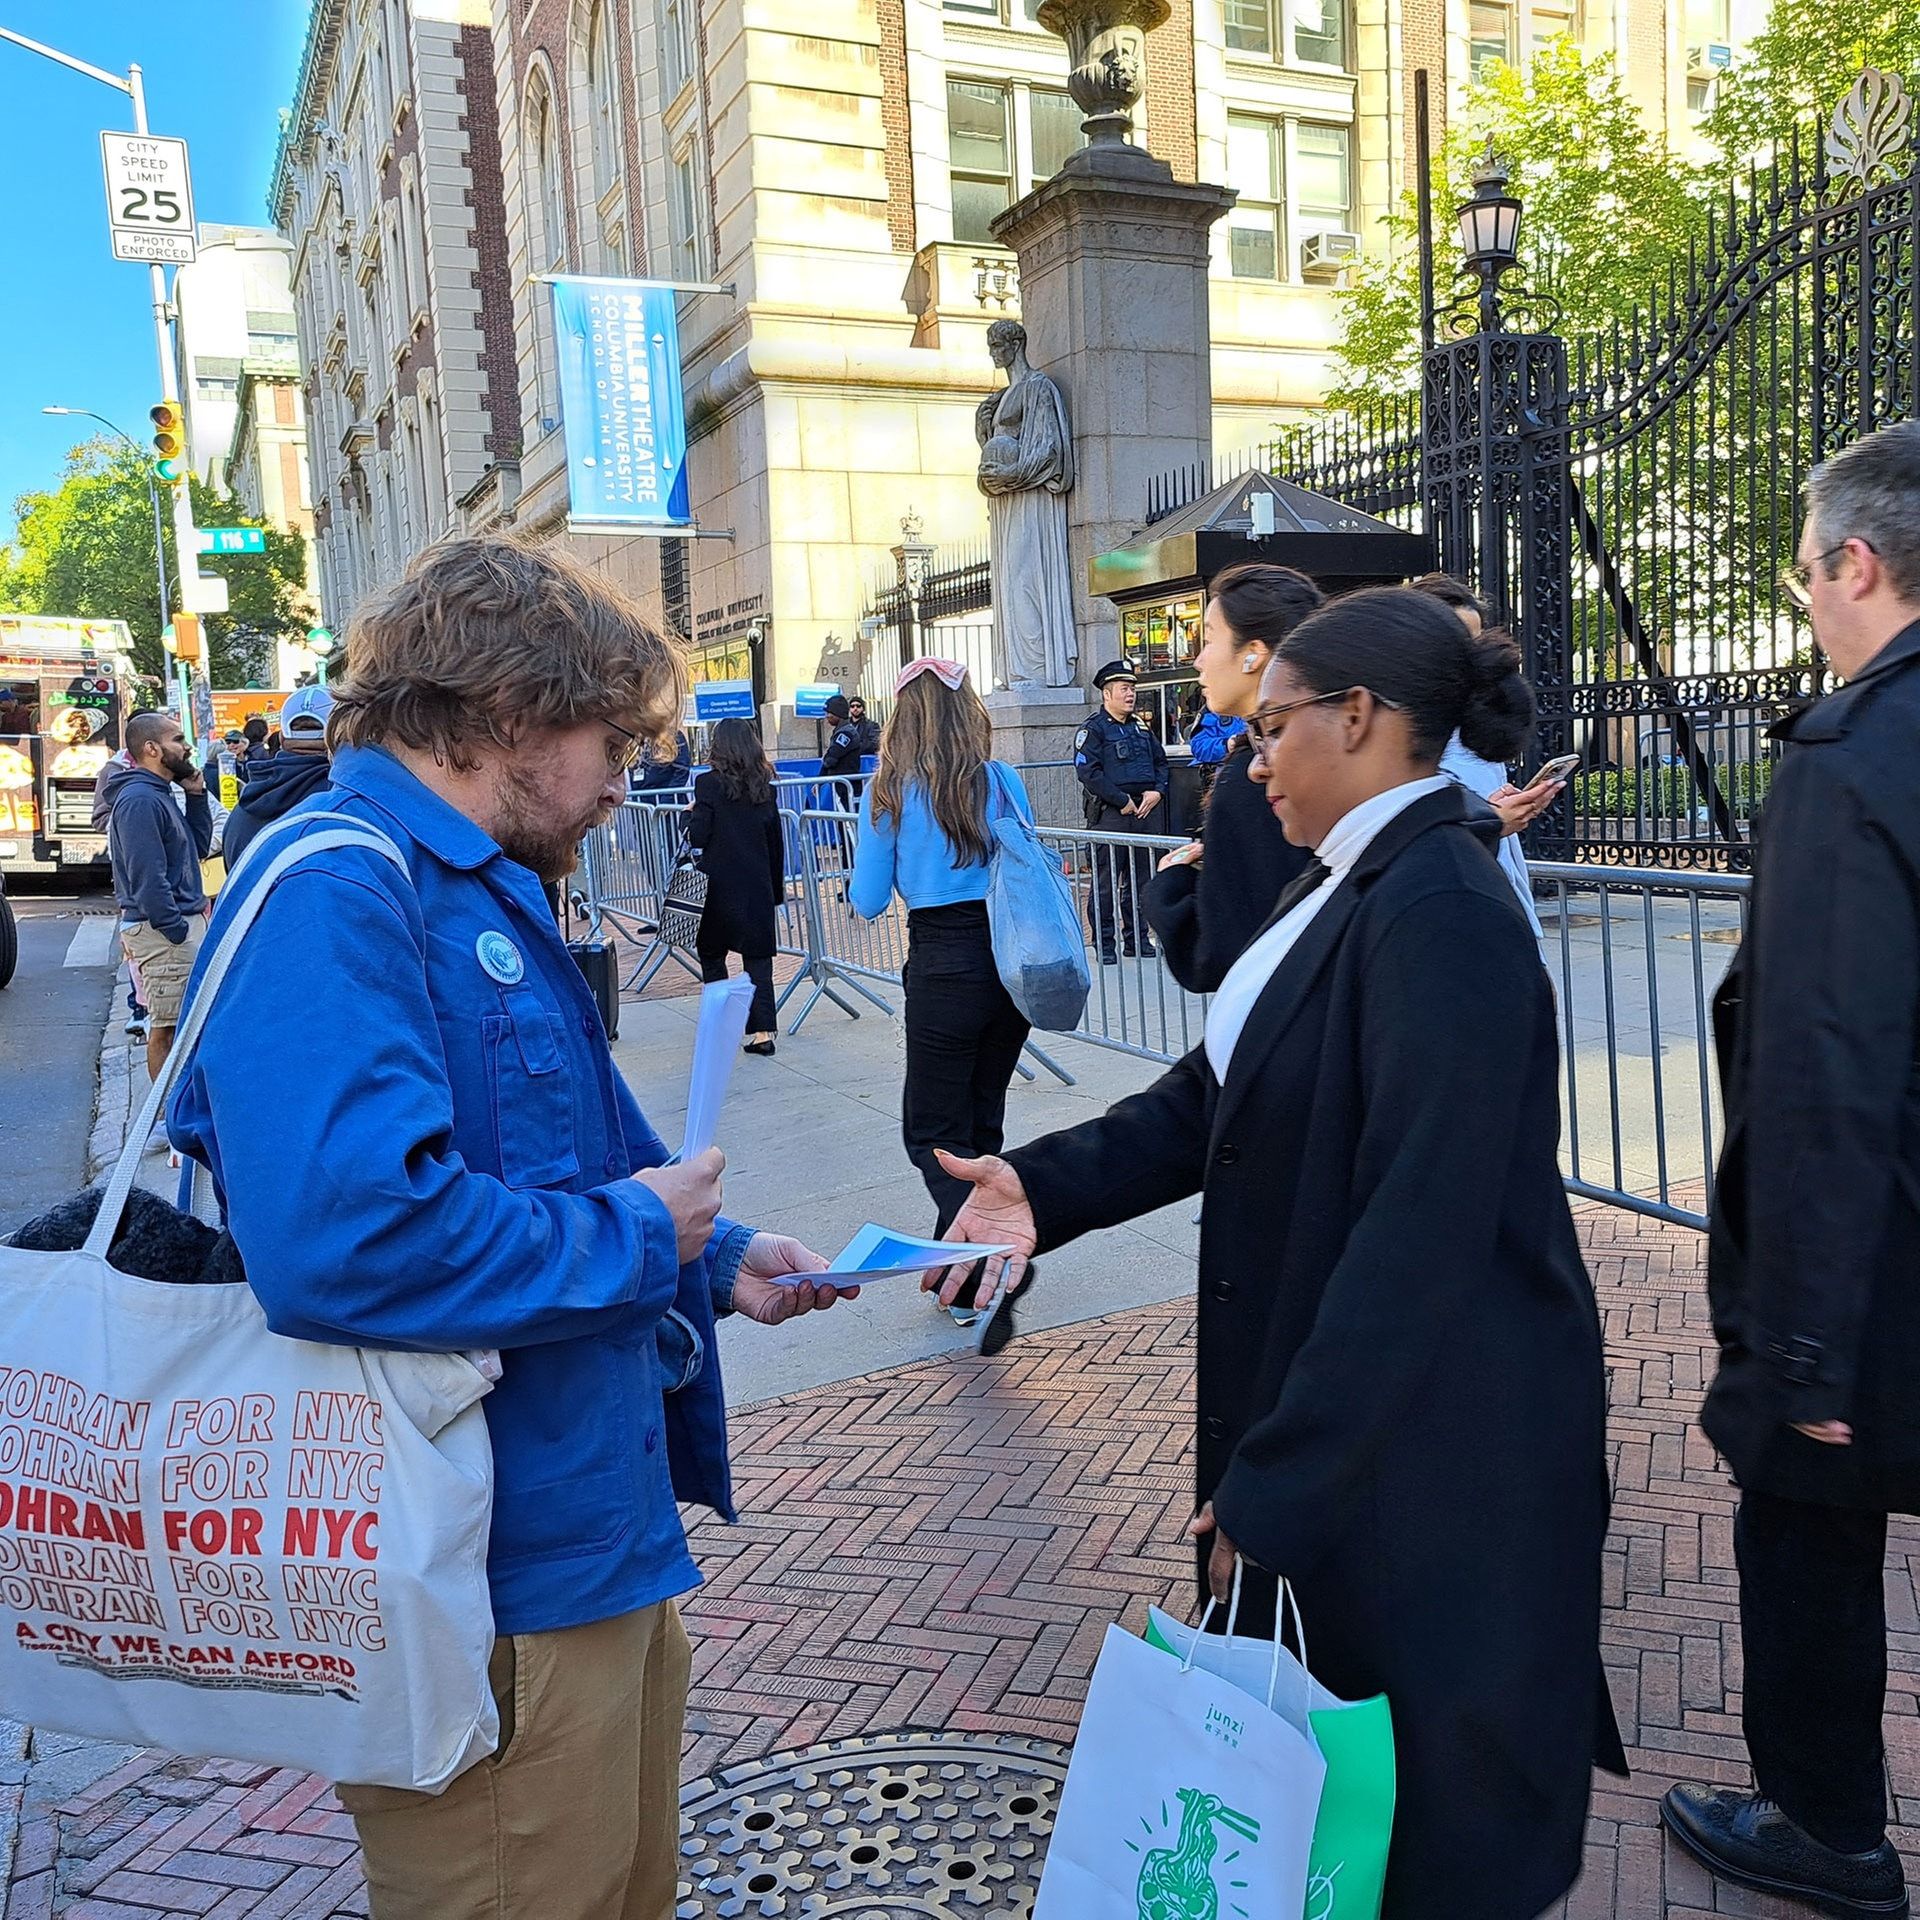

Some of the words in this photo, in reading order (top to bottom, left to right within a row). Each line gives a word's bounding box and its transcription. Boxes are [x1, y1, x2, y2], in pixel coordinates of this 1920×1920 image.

[121, 156, 168, 170] SPEED
[126, 142, 158, 154] CITY
[128, 171, 164, 183] LIMIT
[120, 187, 181, 223] 25
[121, 244, 188, 258] ENFORCED
[133, 235, 175, 247] PHOTO
[590, 294, 605, 368] SCHOOL
[604, 293, 626, 393] COLUMBIA
[621, 294, 651, 403] MILLER
[600, 412, 613, 446] THE
[612, 395, 635, 504] UNIVERSITY
[630, 403, 658, 504] THEATRE
[602, 457, 617, 501] ARTS
[220, 531, 244, 549] 116
[727, 593, 763, 617] UNIVERSITY
[799, 666, 849, 677] DODGE
[166, 1393, 275, 1449] FOR
[293, 1390, 385, 1447] NYC
[0, 1424, 140, 1504] OHRAN
[162, 1449, 269, 1503] FOR
[287, 1448, 384, 1504] NYC
[163, 1507, 264, 1555] FOR
[282, 1507, 379, 1560] NYC
[0, 1534, 155, 1593] OHRAN
[169, 1556, 271, 1601] FOR
[282, 1564, 379, 1611] NYC
[0, 1575, 167, 1632] OHRAN
[179, 1598, 280, 1640] FOR
[290, 1607, 387, 1652] NYC
[16, 1622, 39, 1640] A
[45, 1623, 103, 1653] CITY
[111, 1634, 163, 1654] WE
[168, 1645, 235, 1664] CAN
[245, 1649, 356, 1679] AFFORD
[18, 1639, 63, 1652] Freeze
[120, 1653, 149, 1665] Fast
[152, 1655, 164, 1666] &
[166, 1656, 191, 1674] Free
[193, 1665, 237, 1676] Buses.
[239, 1665, 299, 1682] Universal
[302, 1671, 362, 1693] Childcare.
[1206, 1703, 1245, 1736] junzi
